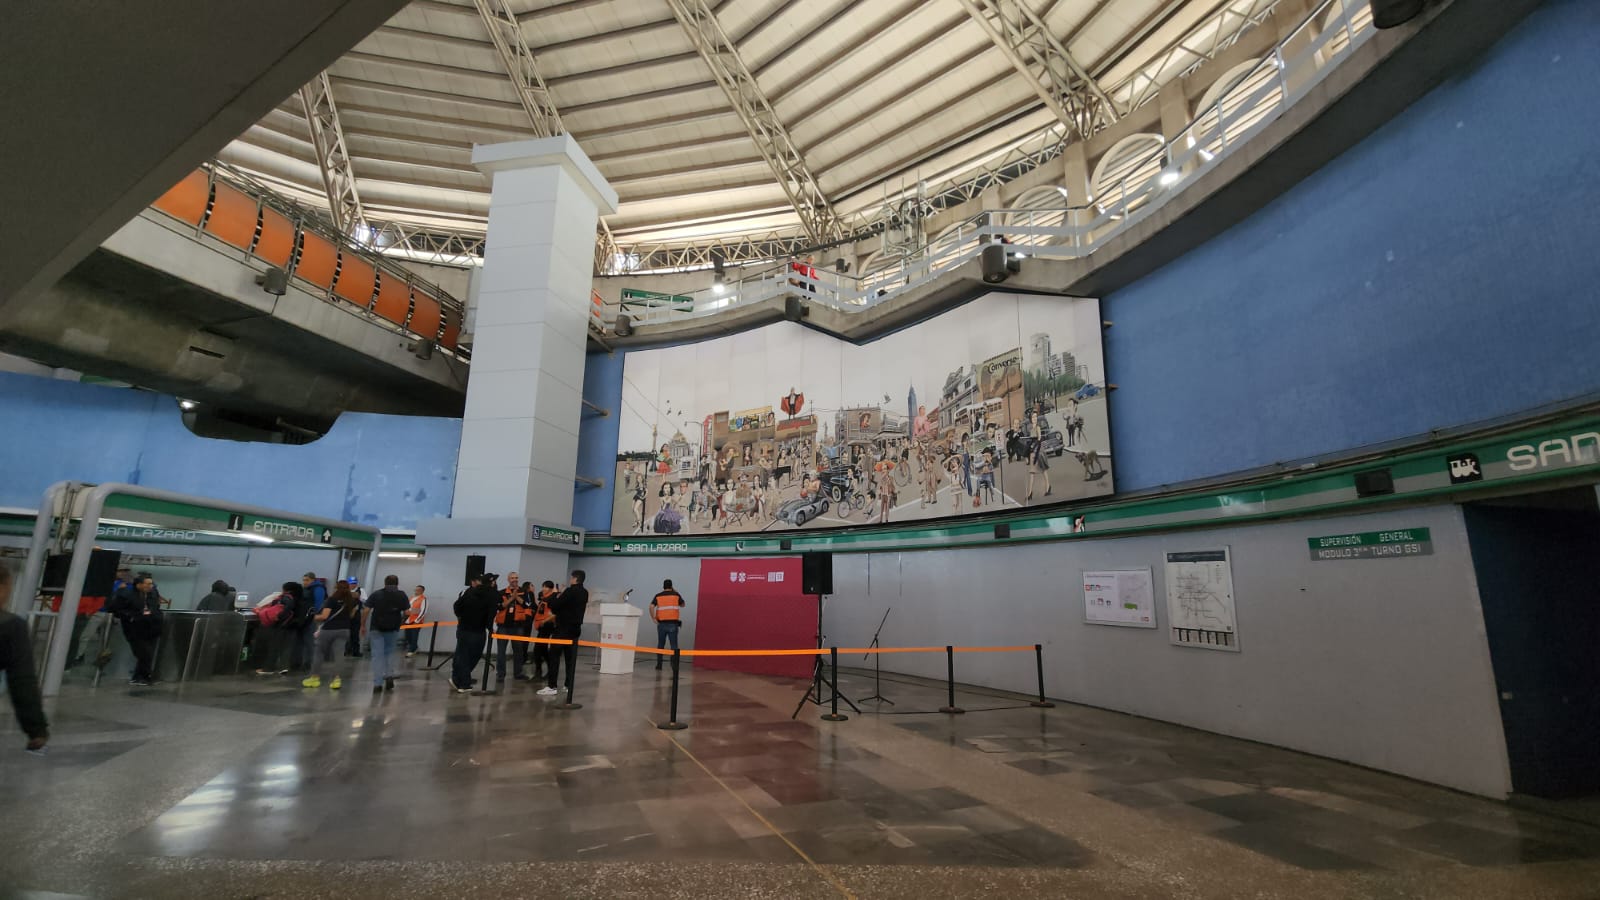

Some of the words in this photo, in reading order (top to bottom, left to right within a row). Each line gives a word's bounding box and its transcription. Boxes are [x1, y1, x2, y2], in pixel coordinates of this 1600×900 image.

[1506, 431, 1600, 471] SAN
[96, 525, 127, 536] SAN
[131, 527, 196, 540] LAZARO
[254, 520, 315, 540] ENTRADA
[1379, 531, 1414, 542] GENERAL
[626, 543, 647, 552] SAN
[650, 543, 688, 552] LAZARO
[1370, 544, 1401, 556] TURNO
